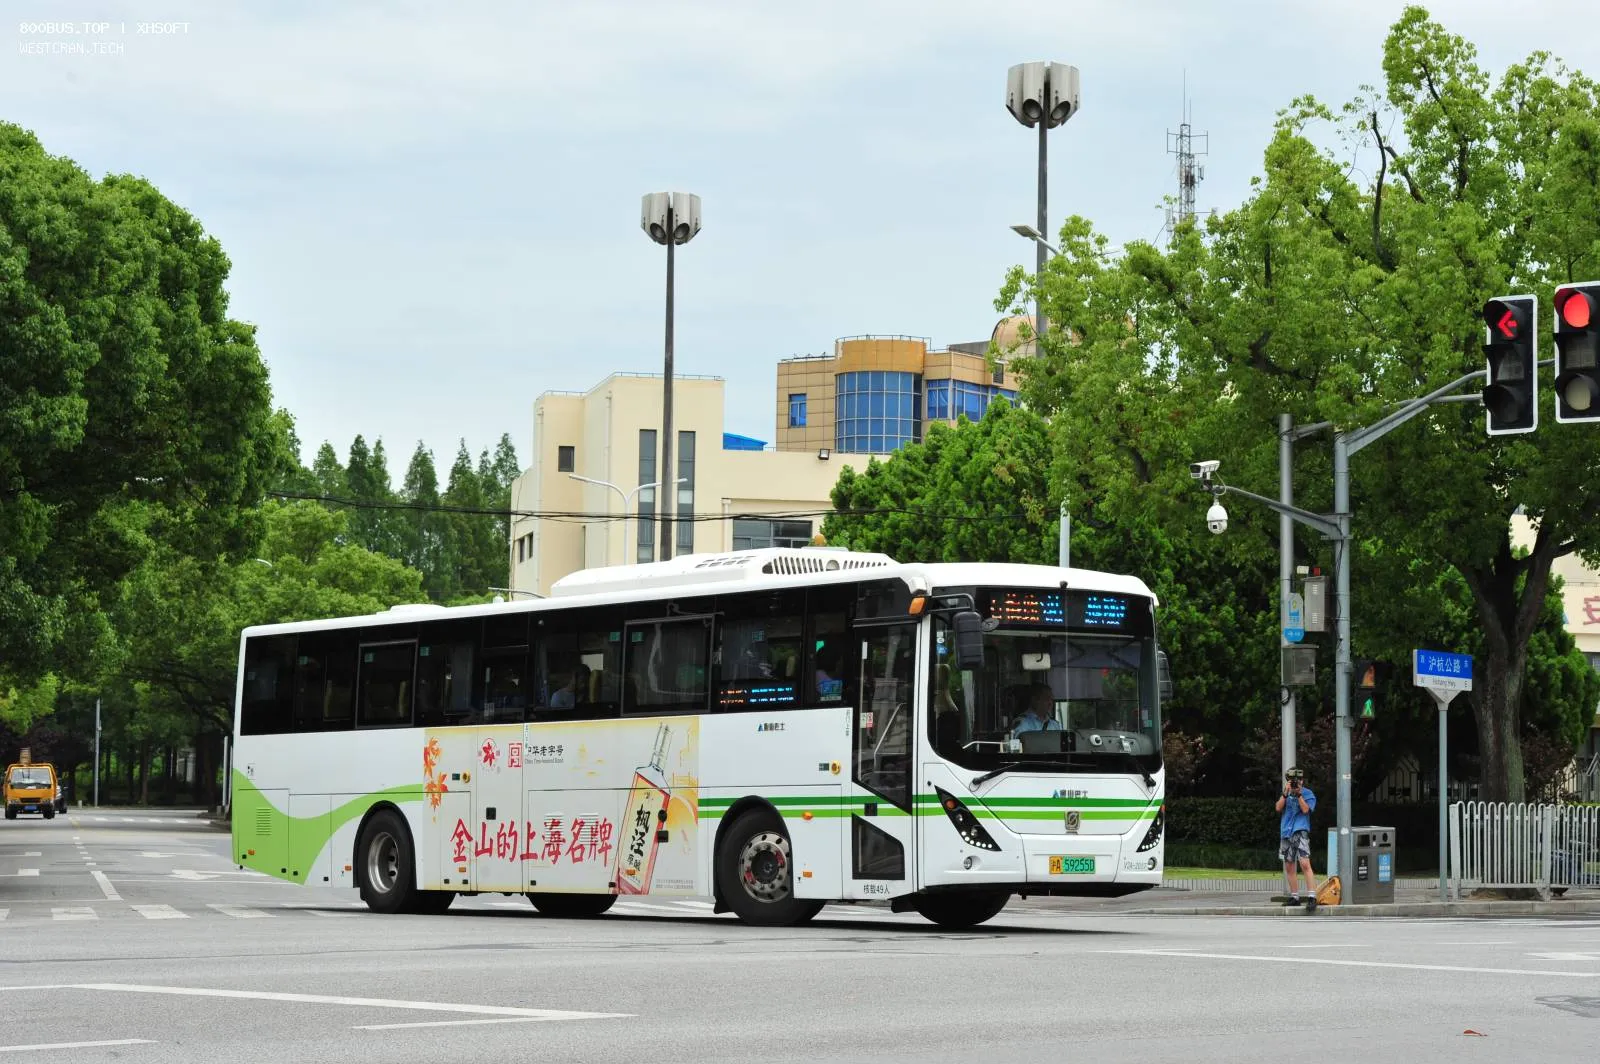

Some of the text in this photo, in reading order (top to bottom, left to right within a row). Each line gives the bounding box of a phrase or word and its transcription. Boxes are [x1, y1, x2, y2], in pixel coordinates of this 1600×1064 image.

[1428, 656, 1461, 673] 沪杭公路
[450, 817, 613, 867] 金山的上海名牌
[863, 884, 890, 894] 核载49人
